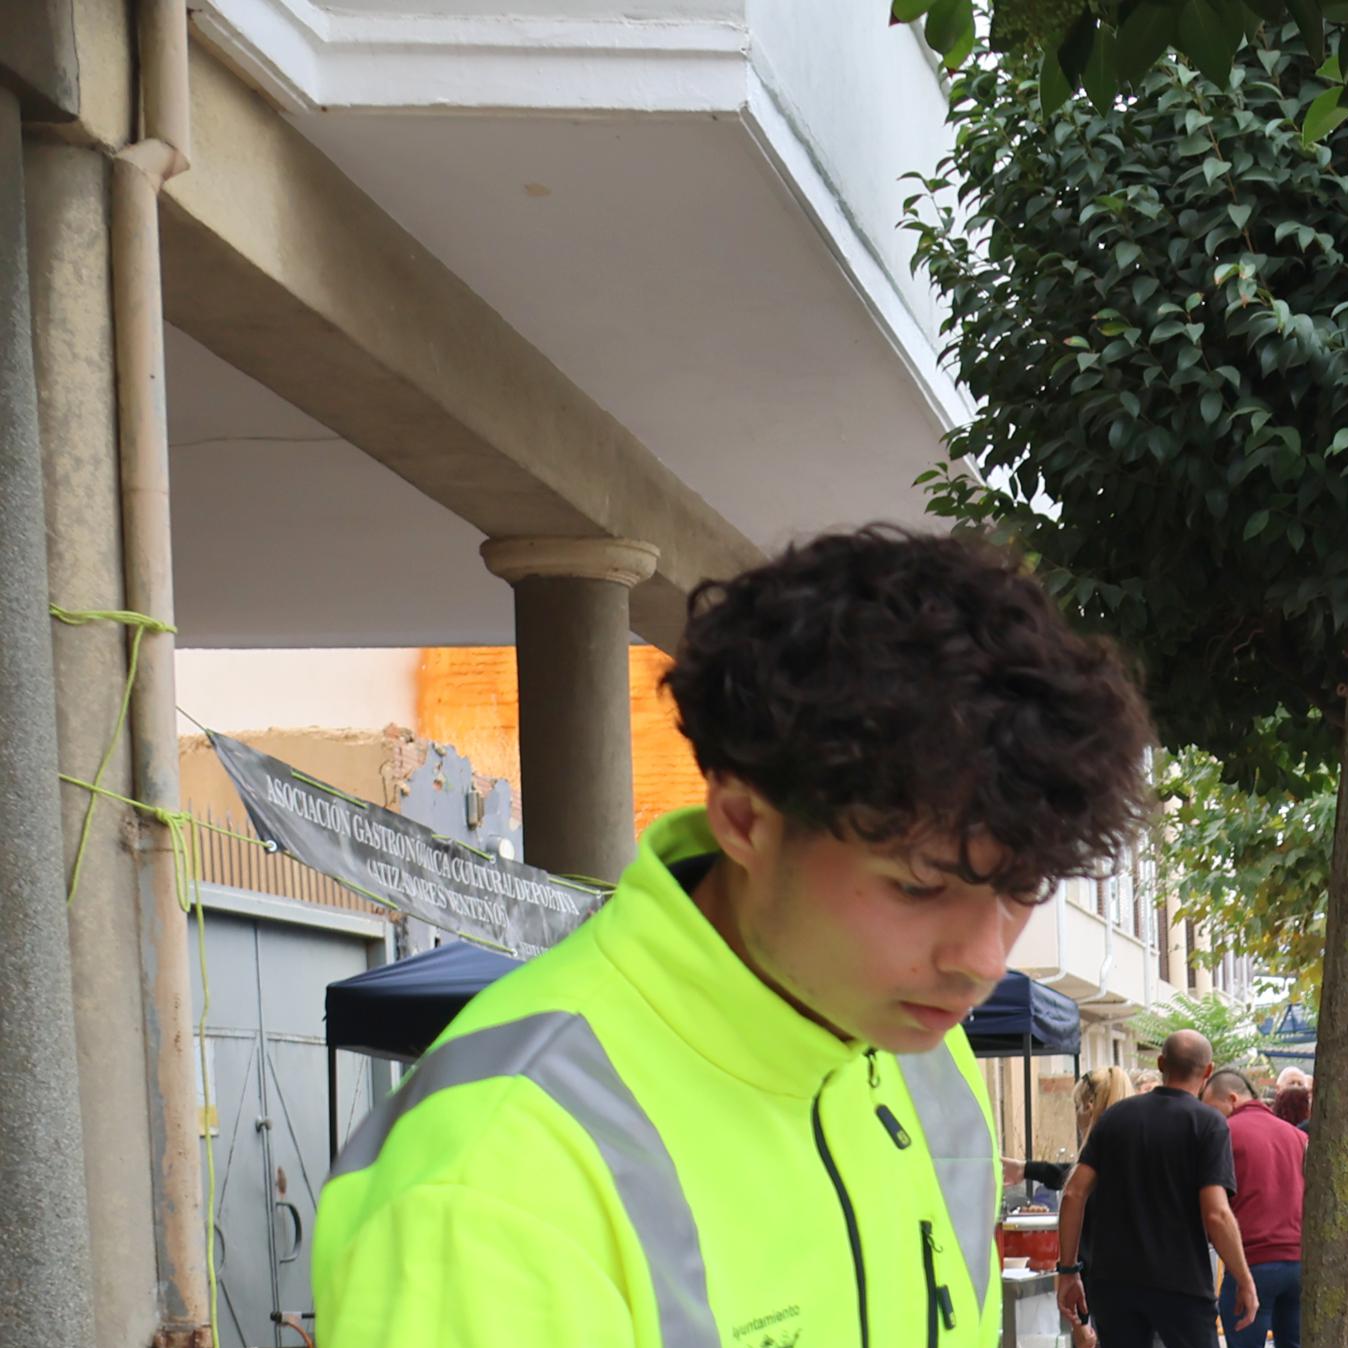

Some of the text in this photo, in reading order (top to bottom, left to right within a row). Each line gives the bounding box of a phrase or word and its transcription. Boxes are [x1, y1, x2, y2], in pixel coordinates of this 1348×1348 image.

[266, 774, 352, 838] ASOCIACIÓN
[352, 813, 452, 880] GASTRONÓMICA
[451, 856, 516, 898] CULTURAL
